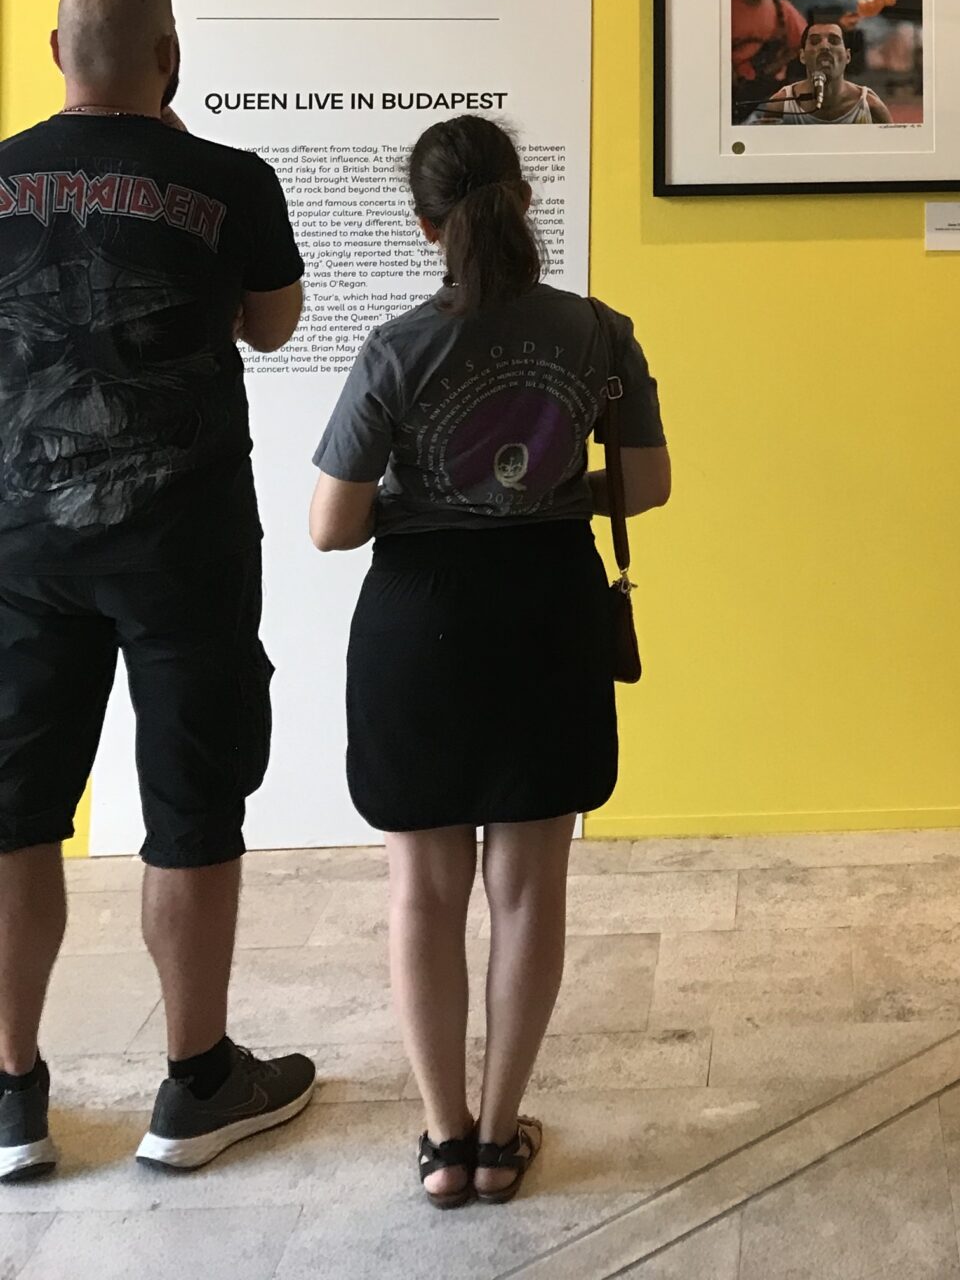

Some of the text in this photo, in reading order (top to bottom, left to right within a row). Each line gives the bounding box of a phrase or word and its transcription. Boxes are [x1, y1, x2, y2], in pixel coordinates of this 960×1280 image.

[205, 93, 508, 114] QUEEN LIVE IN BUDAPEST
[329, 144, 350, 152] from
[300, 155, 327, 163] Soviet
[385, 154, 403, 162] that
[523, 154, 555, 162] concert
[295, 165, 316, 175] risky
[372, 164, 395, 172] band
[314, 175, 348, 185] brought
[303, 185, 380, 195] rock band beyond
[324, 198, 357, 206] famous
[358, 198, 395, 206] concerts
[545, 197, 564, 205] date
[52, 169, 228, 253] MAIDEN
[296, 209, 330, 218] popular
[343, 220, 362, 228] very
[300, 228, 420, 238] destined make history
[312, 239, 330, 247] also
[316, 249, 351, 259] jokingly
[354, 249, 391, 259] reported
[325, 259, 354, 269] Queen
[379, 259, 408, 267] hosted
[333, 268, 403, 279] there capture
[304, 279, 327, 287] Denis
[342, 292, 368, 300] which
[326, 302, 413, 312] well Hungarian
[311, 313, 332, 321] Save
[329, 323, 362, 331] entered
[311, 344, 334, 352] Brian
[261, 354, 311, 364] finally have
[256, 364, 318, 373] concert would
[485, 491, 525, 505] 2022
